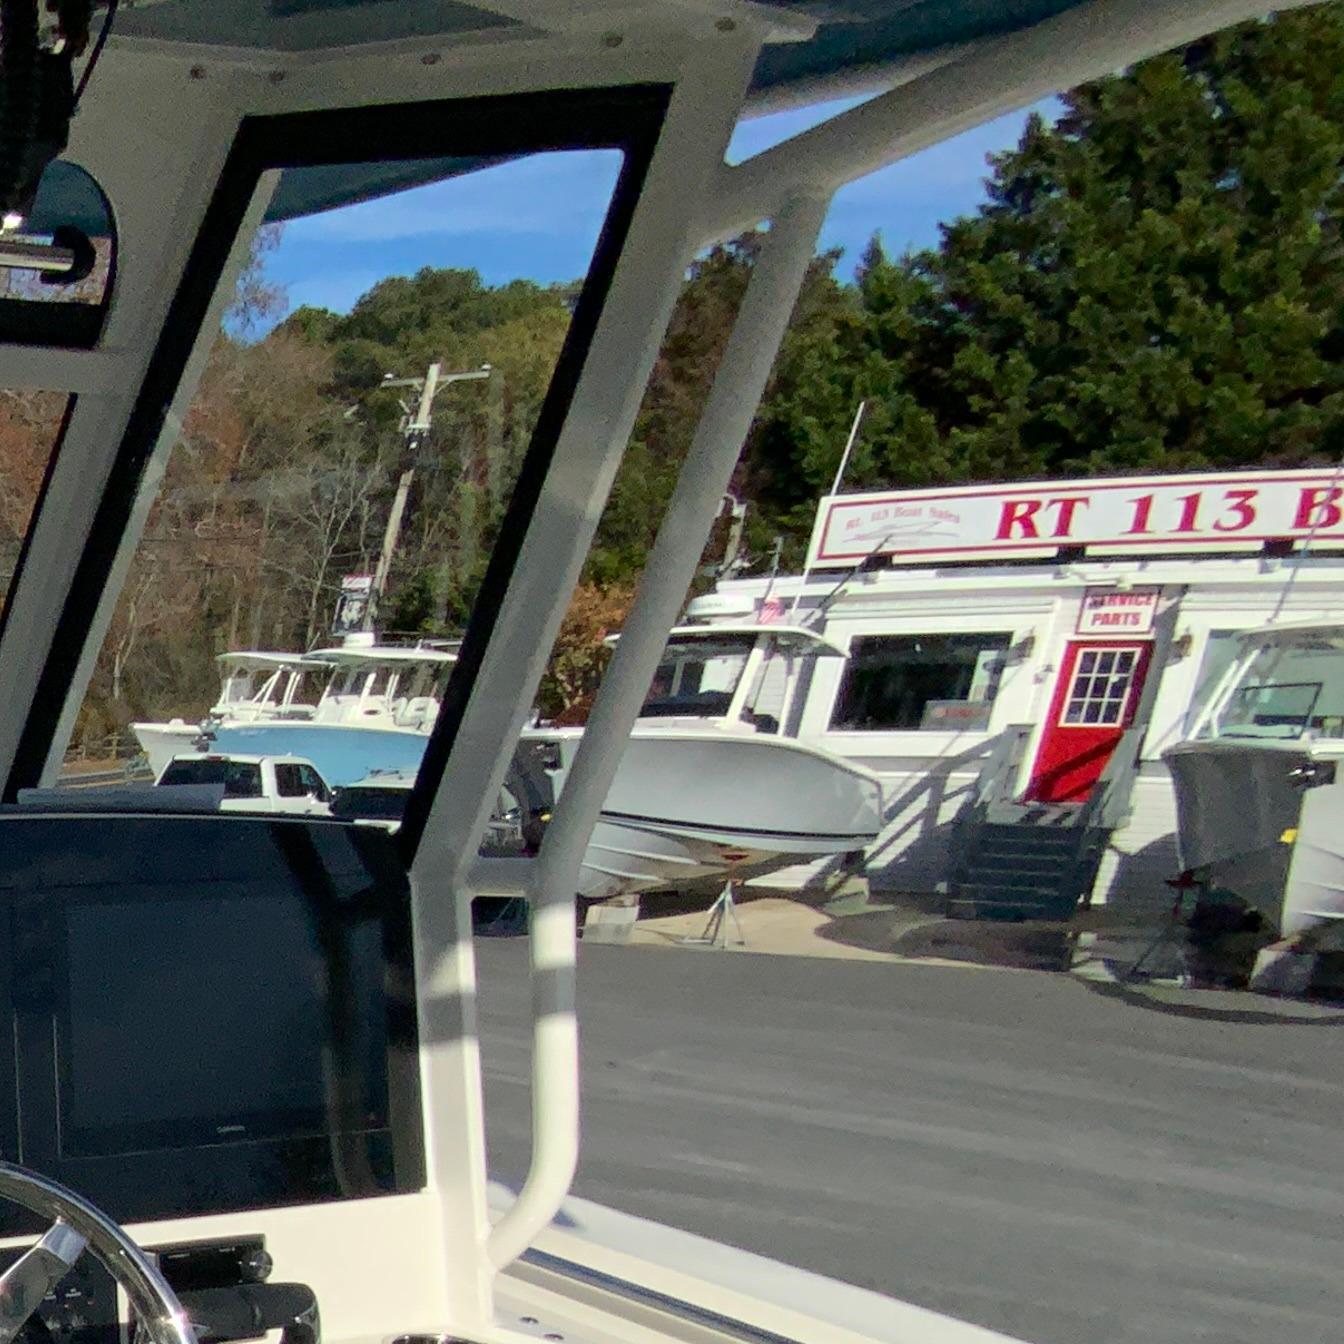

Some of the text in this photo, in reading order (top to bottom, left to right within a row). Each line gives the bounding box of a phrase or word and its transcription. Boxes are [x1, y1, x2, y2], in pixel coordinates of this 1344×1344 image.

[993, 497, 1090, 540] RT
[1120, 489, 1259, 535] 113
[1091, 612, 1142, 626] PARTS
